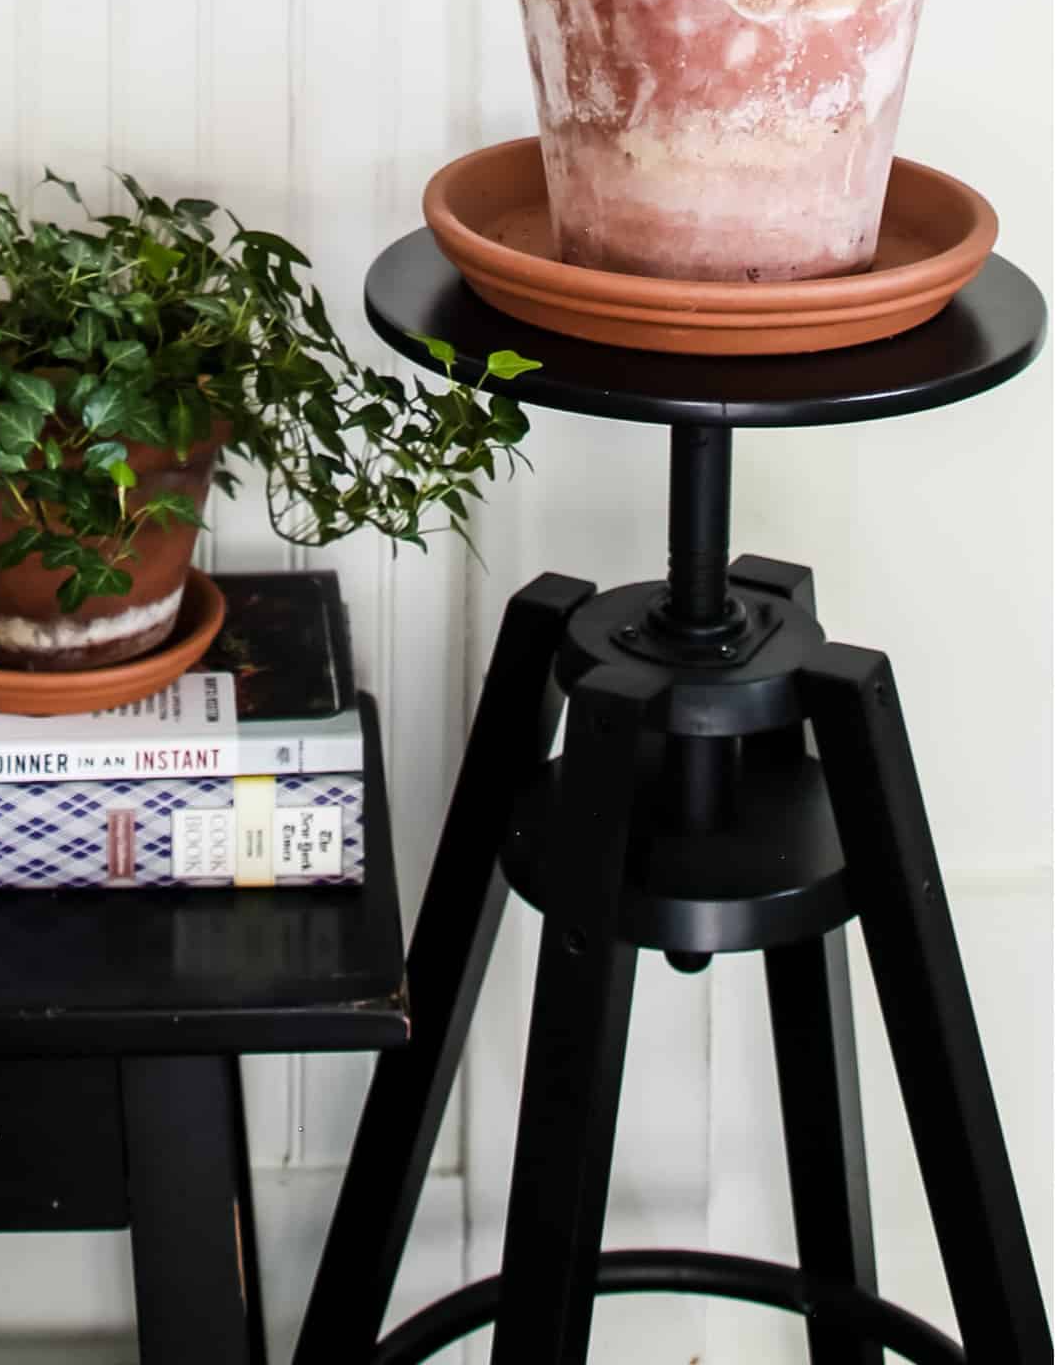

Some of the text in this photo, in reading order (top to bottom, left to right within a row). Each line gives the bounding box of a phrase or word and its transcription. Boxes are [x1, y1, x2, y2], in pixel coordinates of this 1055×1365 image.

[77, 756, 95, 767] IN
[102, 755, 126, 767] AN
[134, 748, 221, 771] INSTANT
[185, 815, 203, 872] BOOK
[209, 813, 227, 871] COOK
[282, 824, 296, 862] Times
[297, 812, 314, 870] New York
[319, 829, 333, 853] The
